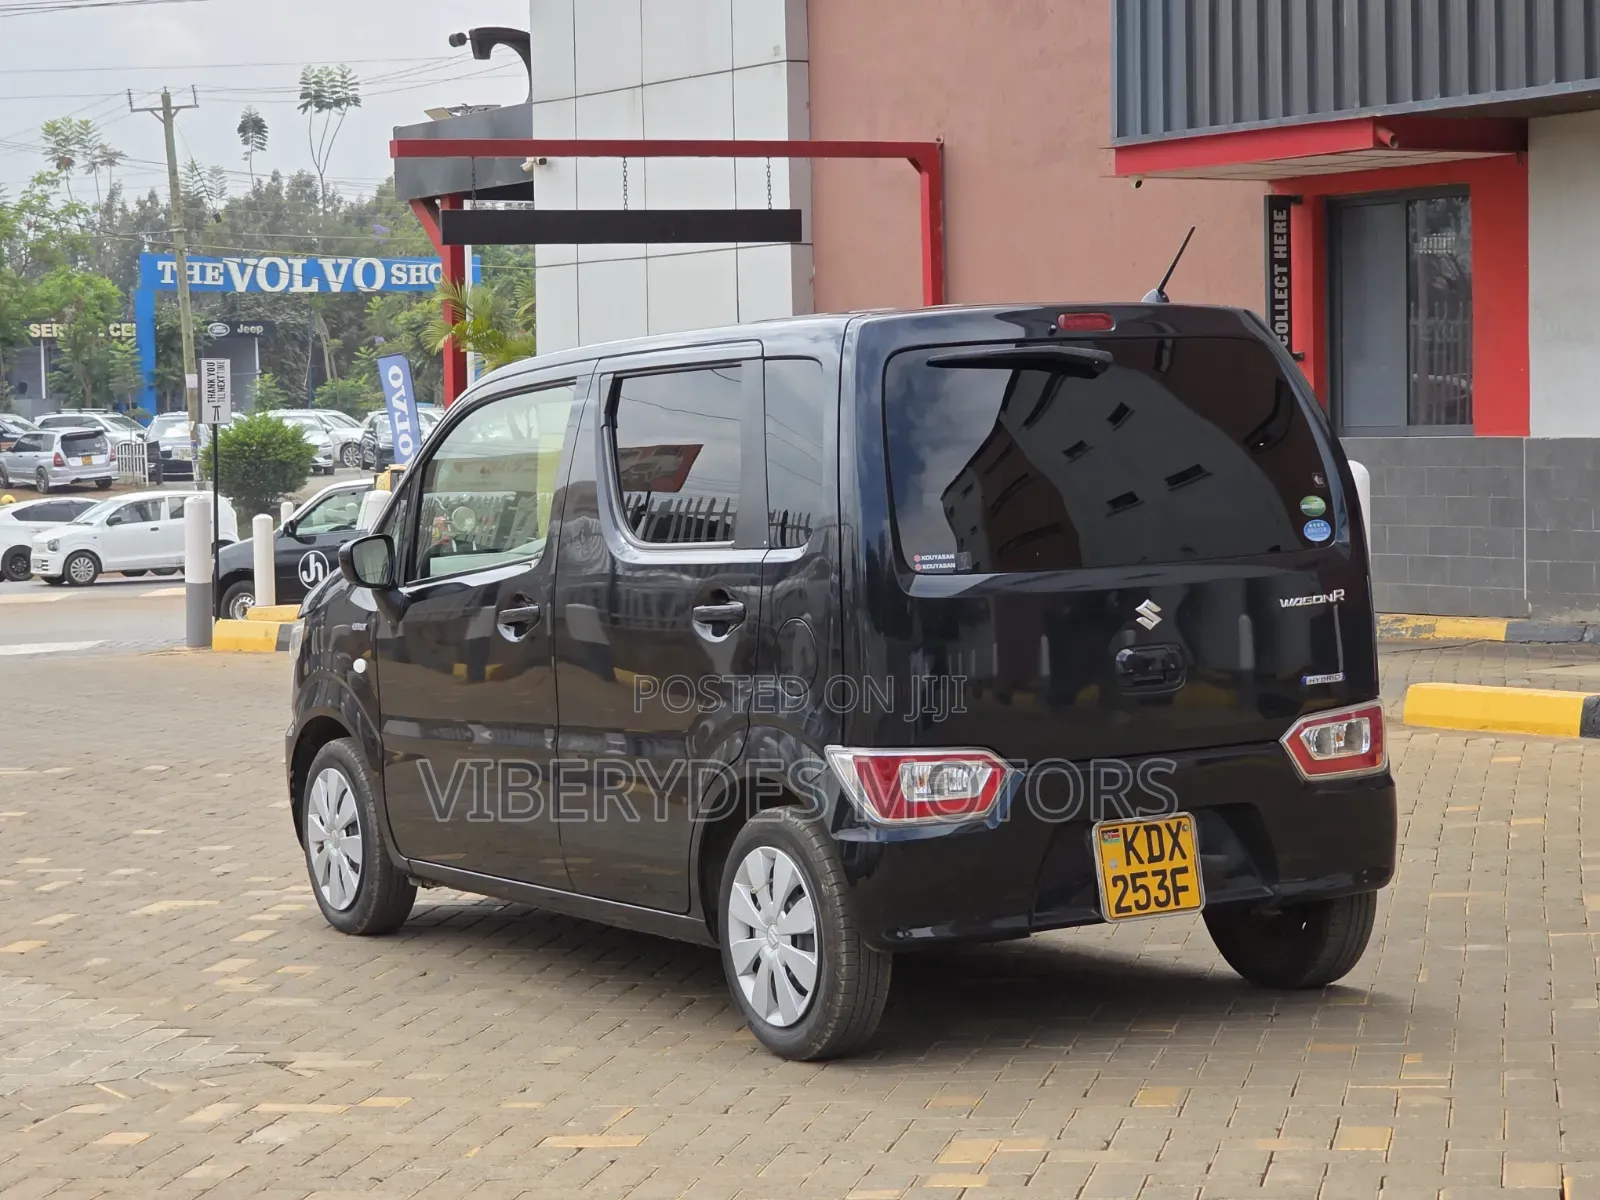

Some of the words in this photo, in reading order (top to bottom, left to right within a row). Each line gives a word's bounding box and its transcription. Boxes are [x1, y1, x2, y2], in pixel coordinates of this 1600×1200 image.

[1273, 209, 1287, 259] HERE
[157, 261, 224, 285] THE
[222, 257, 386, 293] VOLVO
[391, 263, 443, 285] SHO
[237, 324, 264, 335] Jeep
[206, 361, 216, 377] YOU
[206, 378, 217, 404] THANK
[217, 375, 226, 392] NEXT
[1308, 673, 1342, 684] HYBRID
[1122, 820, 1187, 867] KDX
[1111, 865, 1190, 915] 253F
